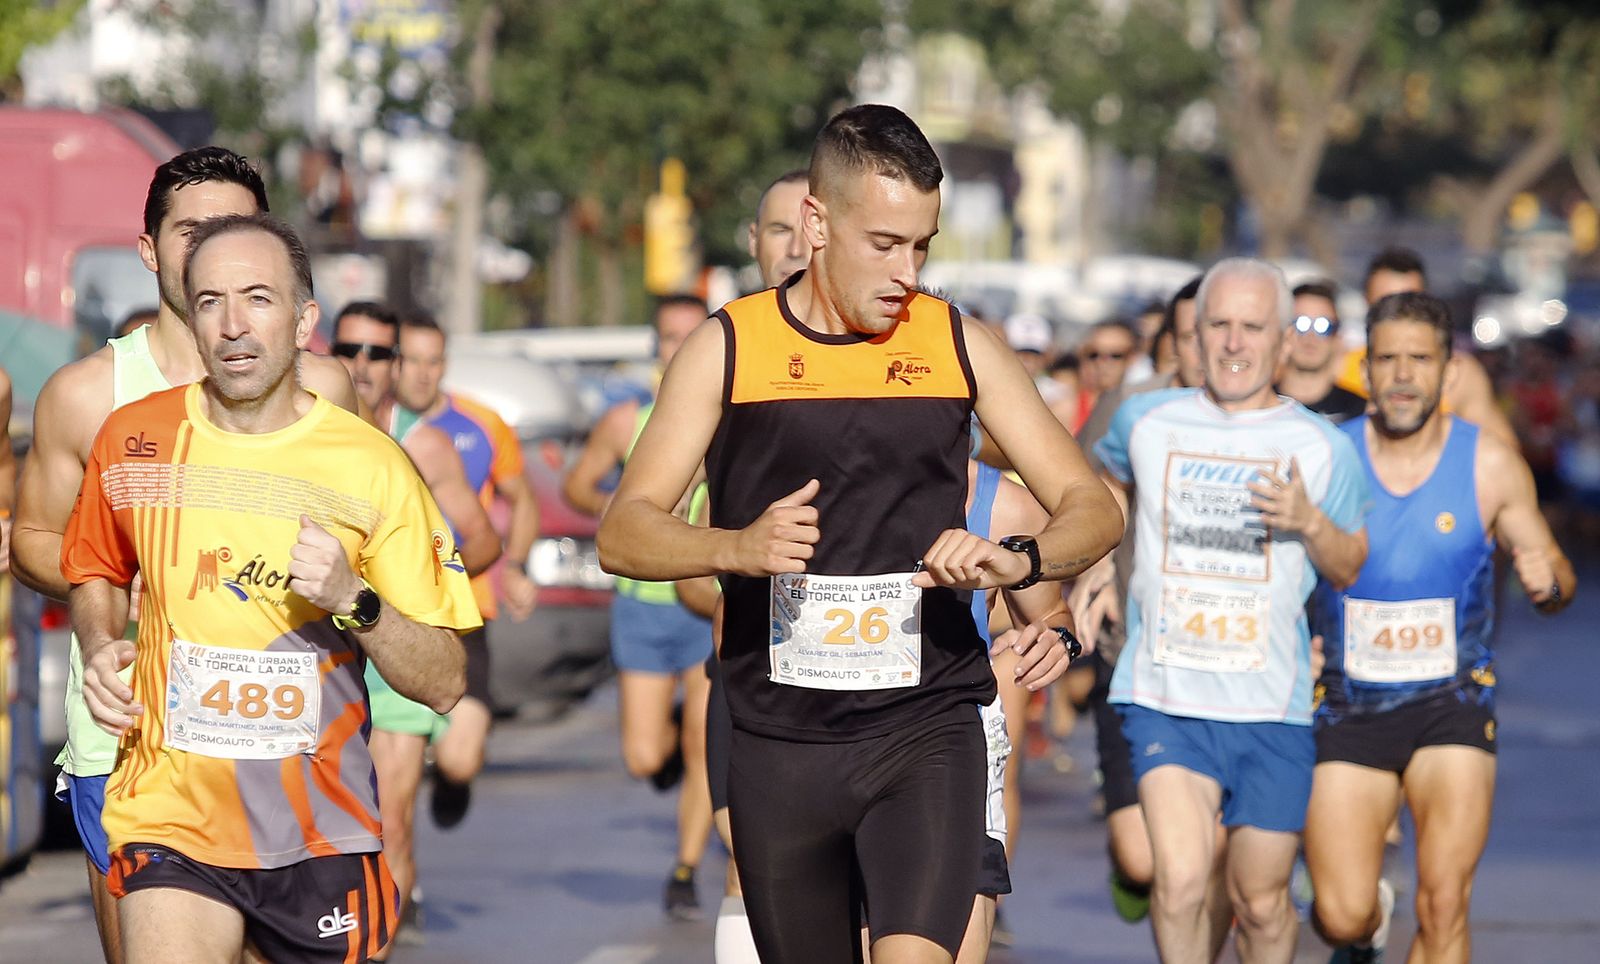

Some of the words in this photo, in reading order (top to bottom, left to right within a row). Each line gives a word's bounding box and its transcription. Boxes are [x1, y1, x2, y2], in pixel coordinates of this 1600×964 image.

[903, 360, 931, 375] Álora
[124, 431, 157, 457] als
[234, 553, 300, 591] Álor
[790, 589, 804, 600] EL
[808, 591, 855, 603] TORCAL
[861, 591, 876, 602] LA
[879, 589, 902, 600] PAZ
[811, 582, 859, 592] CARRERA
[861, 581, 901, 592] URBANA
[822, 606, 890, 646] 26
[1183, 611, 1258, 643] 413
[1373, 624, 1444, 651] 499
[187, 656, 201, 668] EL
[205, 659, 253, 674] TORCAL
[258, 665, 274, 675] LA
[278, 665, 301, 675] PAZ
[208, 651, 256, 664] CARRERA
[258, 656, 301, 666] URBANA
[797, 667, 861, 680] DISMOAUTO
[200, 679, 305, 721] 489
[258, 724, 285, 732] DANIEL
[190, 731, 256, 748] DISMOAUTO
[317, 906, 359, 938] als
